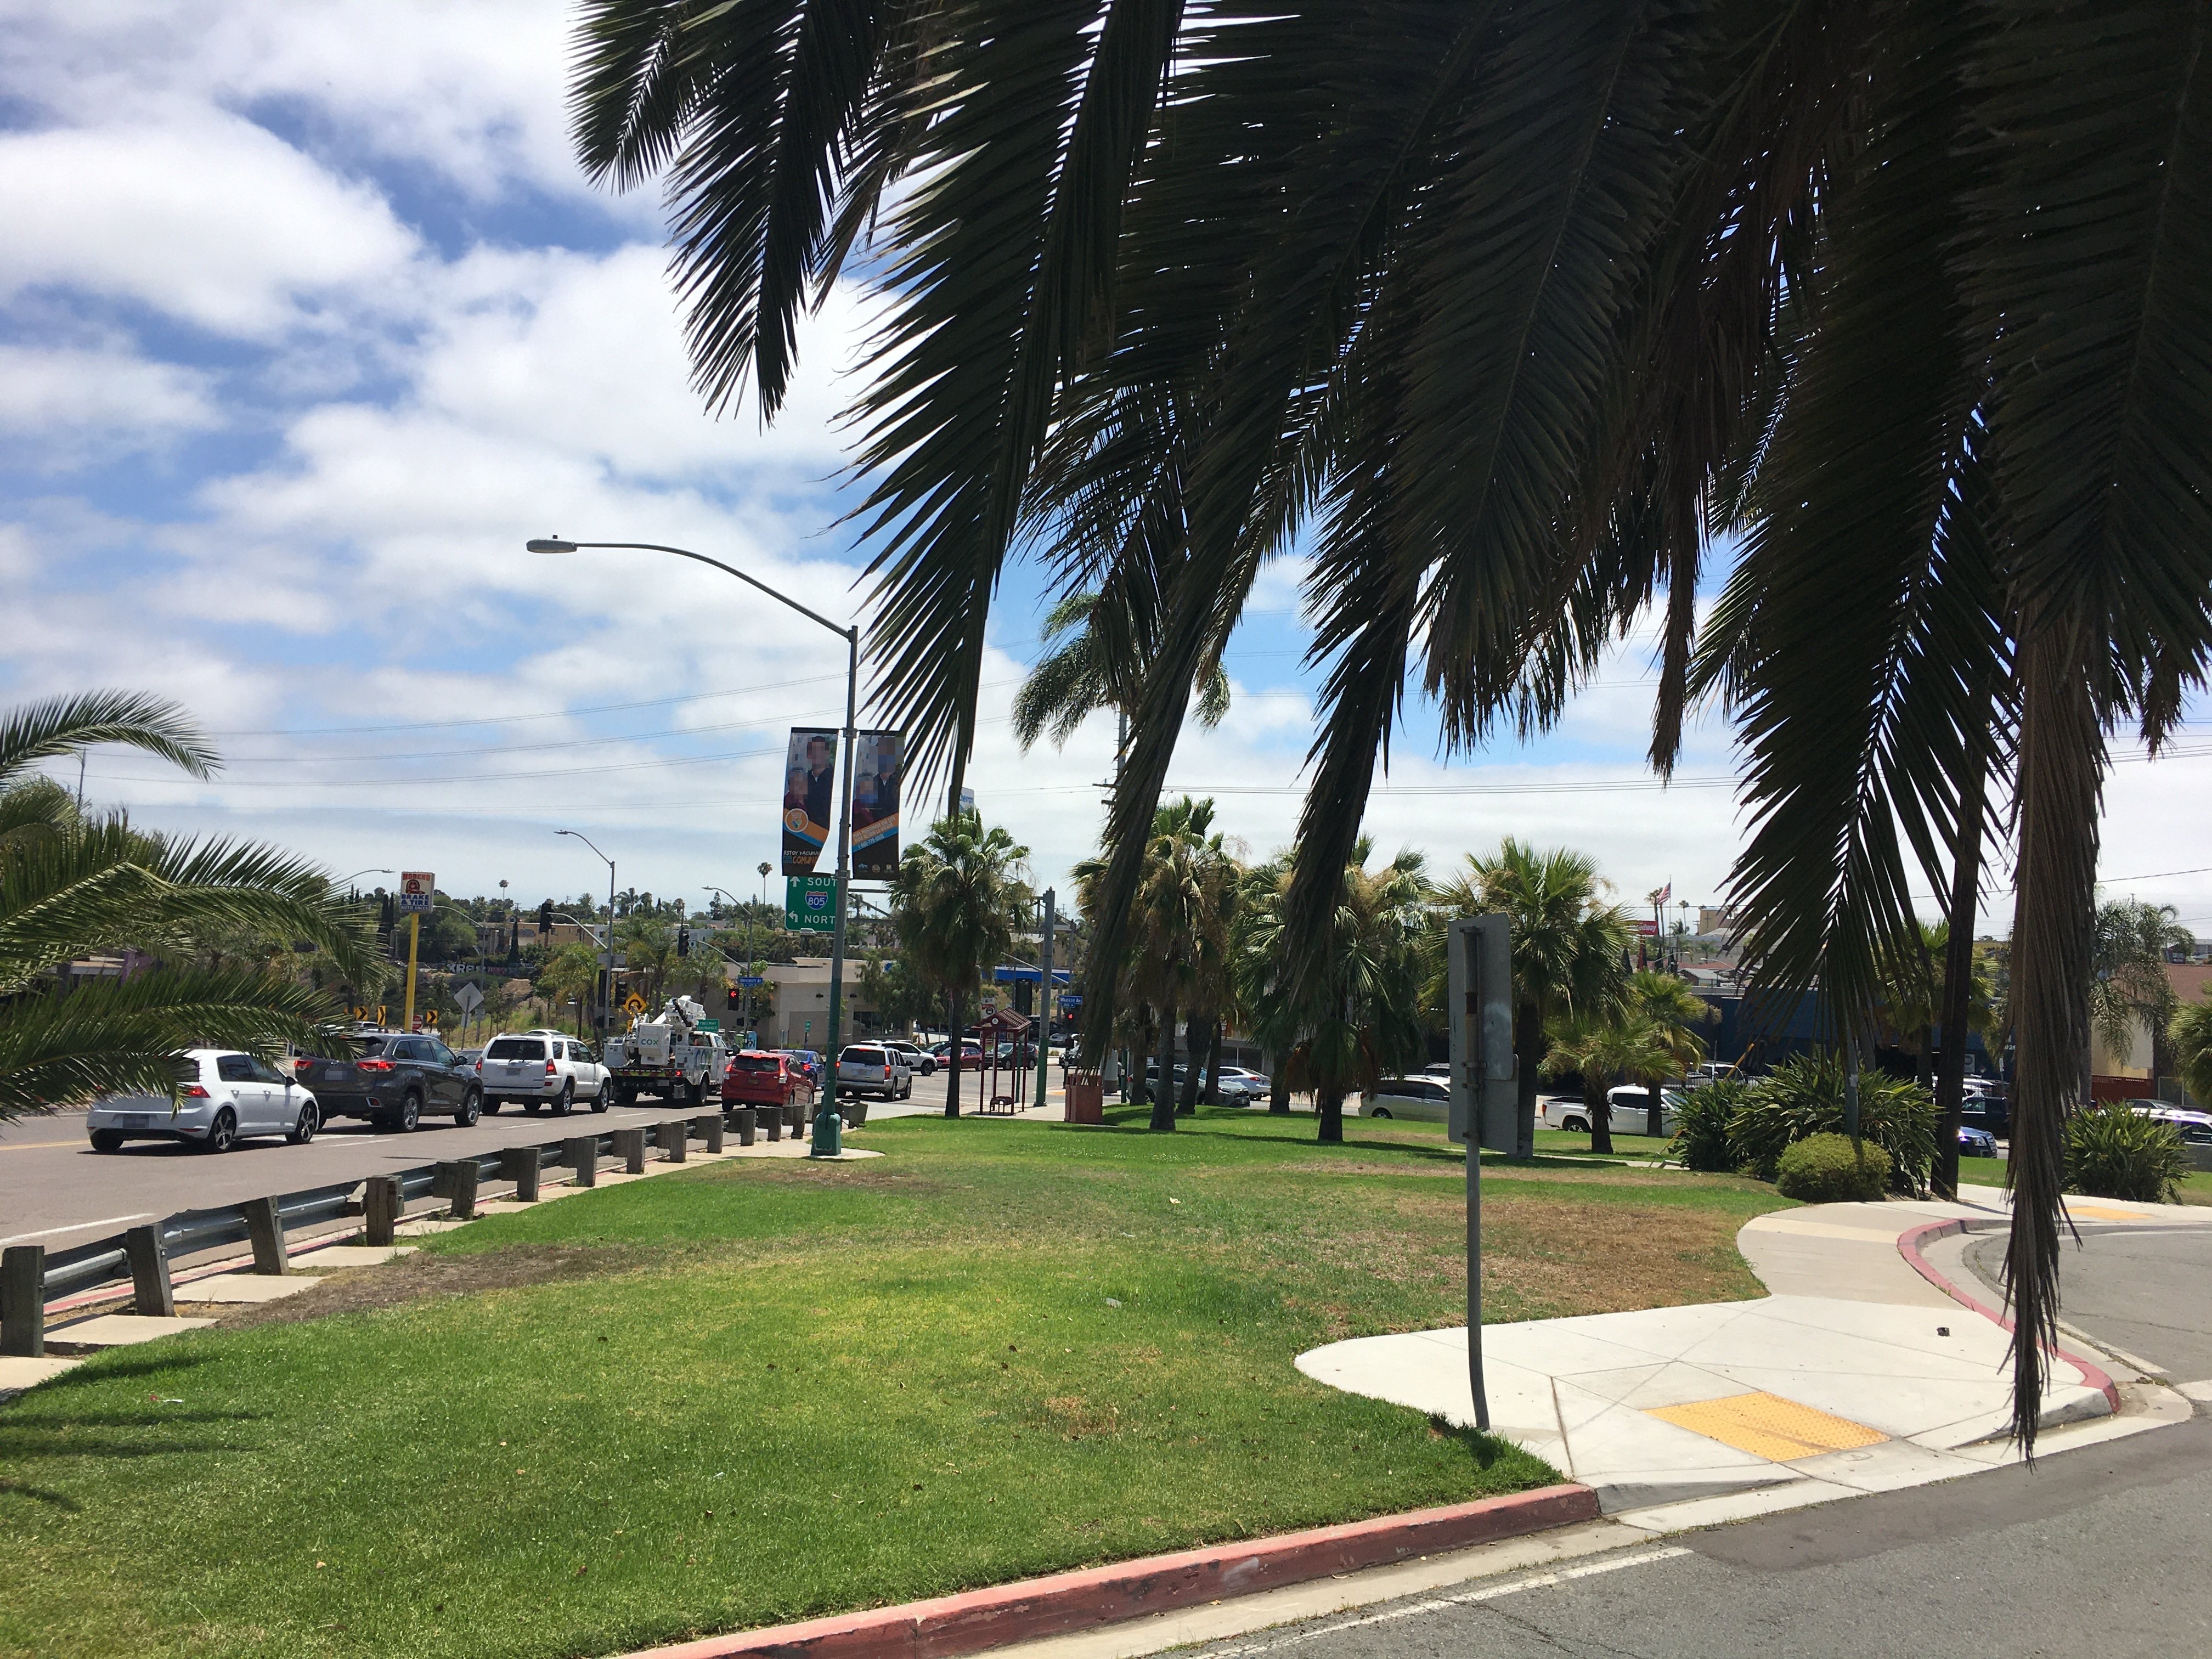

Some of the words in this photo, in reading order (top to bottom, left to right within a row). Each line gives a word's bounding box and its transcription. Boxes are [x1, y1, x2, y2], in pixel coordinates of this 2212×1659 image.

[403, 873, 431, 881] MORENO
[807, 877, 838, 887] SOUT
[808, 897, 825, 906] 805
[804, 915, 836, 924] NORT
